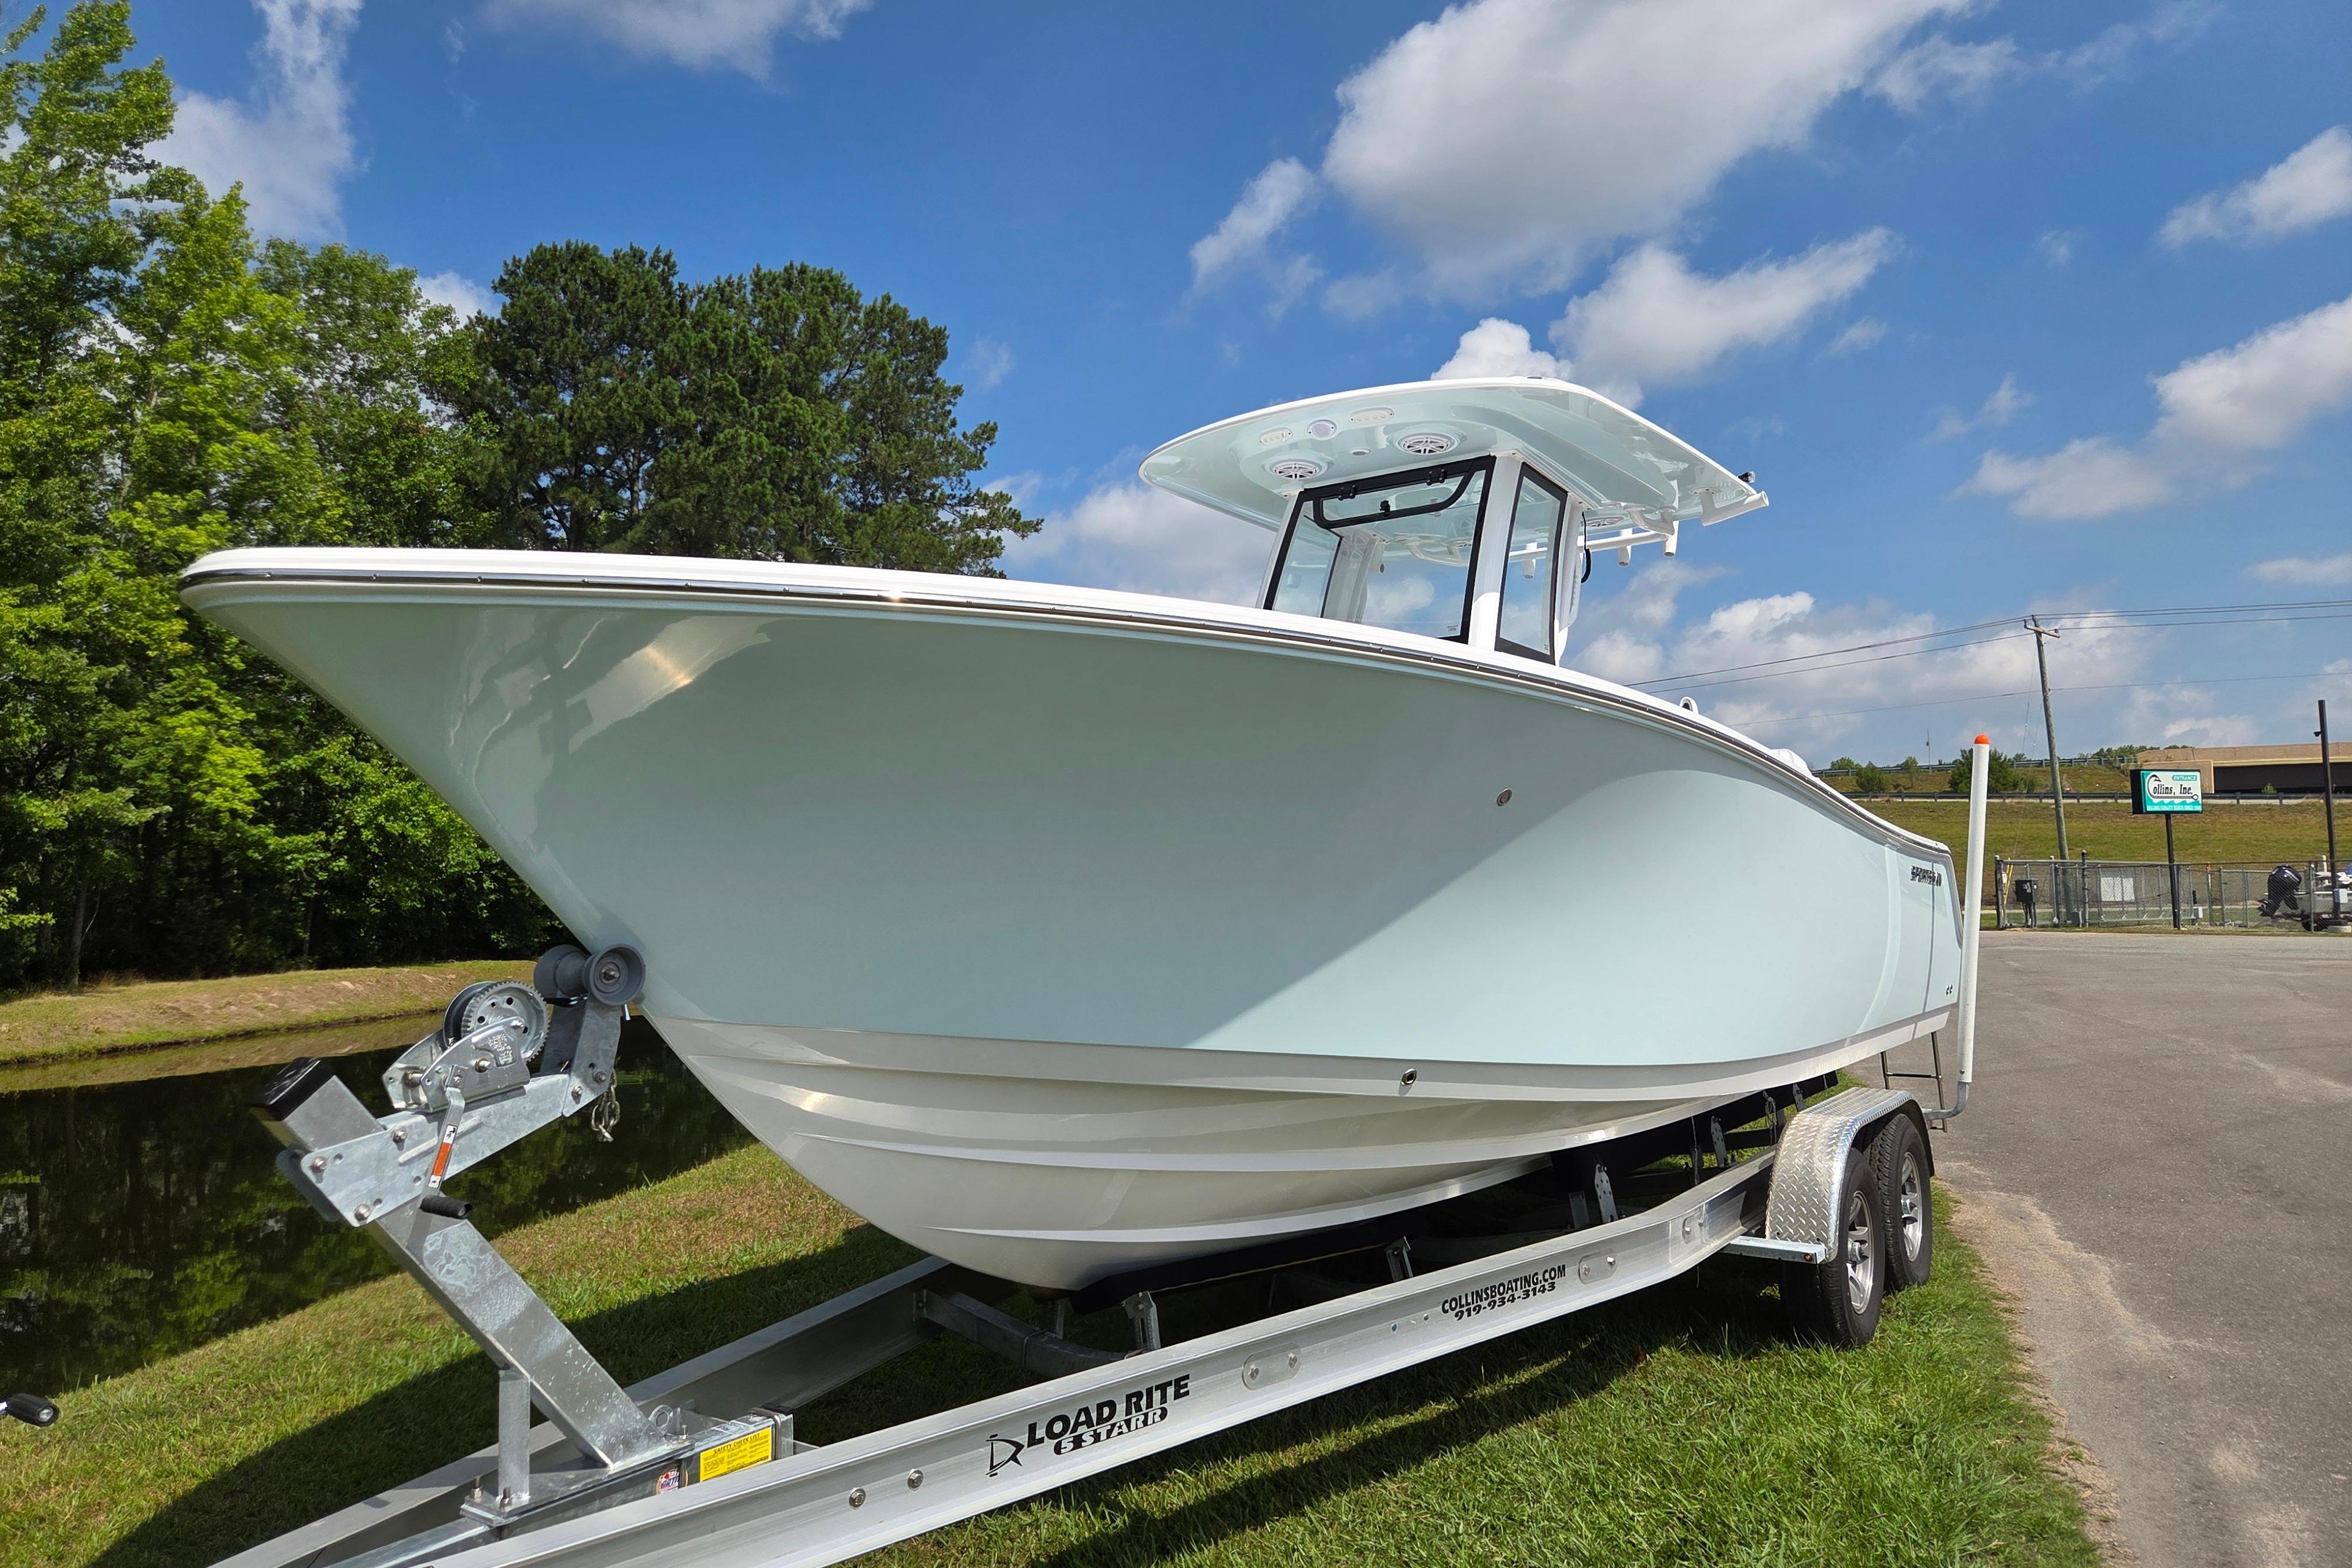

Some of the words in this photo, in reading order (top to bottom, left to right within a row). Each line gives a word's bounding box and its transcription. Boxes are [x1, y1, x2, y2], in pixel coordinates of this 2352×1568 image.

[2179, 784, 2193, 795] Inc.
[1442, 1265, 1566, 1314] COLLINSBOATING.COM
[1454, 1281, 1556, 1321] 919-934-3143
[1027, 1399, 1117, 1449] LOAD
[1125, 1373, 1190, 1417] RITE
[1060, 1439, 1074, 1454] 5
[1081, 1408, 1162, 1447] STARR
[714, 1444, 732, 1454] SAFETY
[733, 1437, 750, 1447] CHECK
